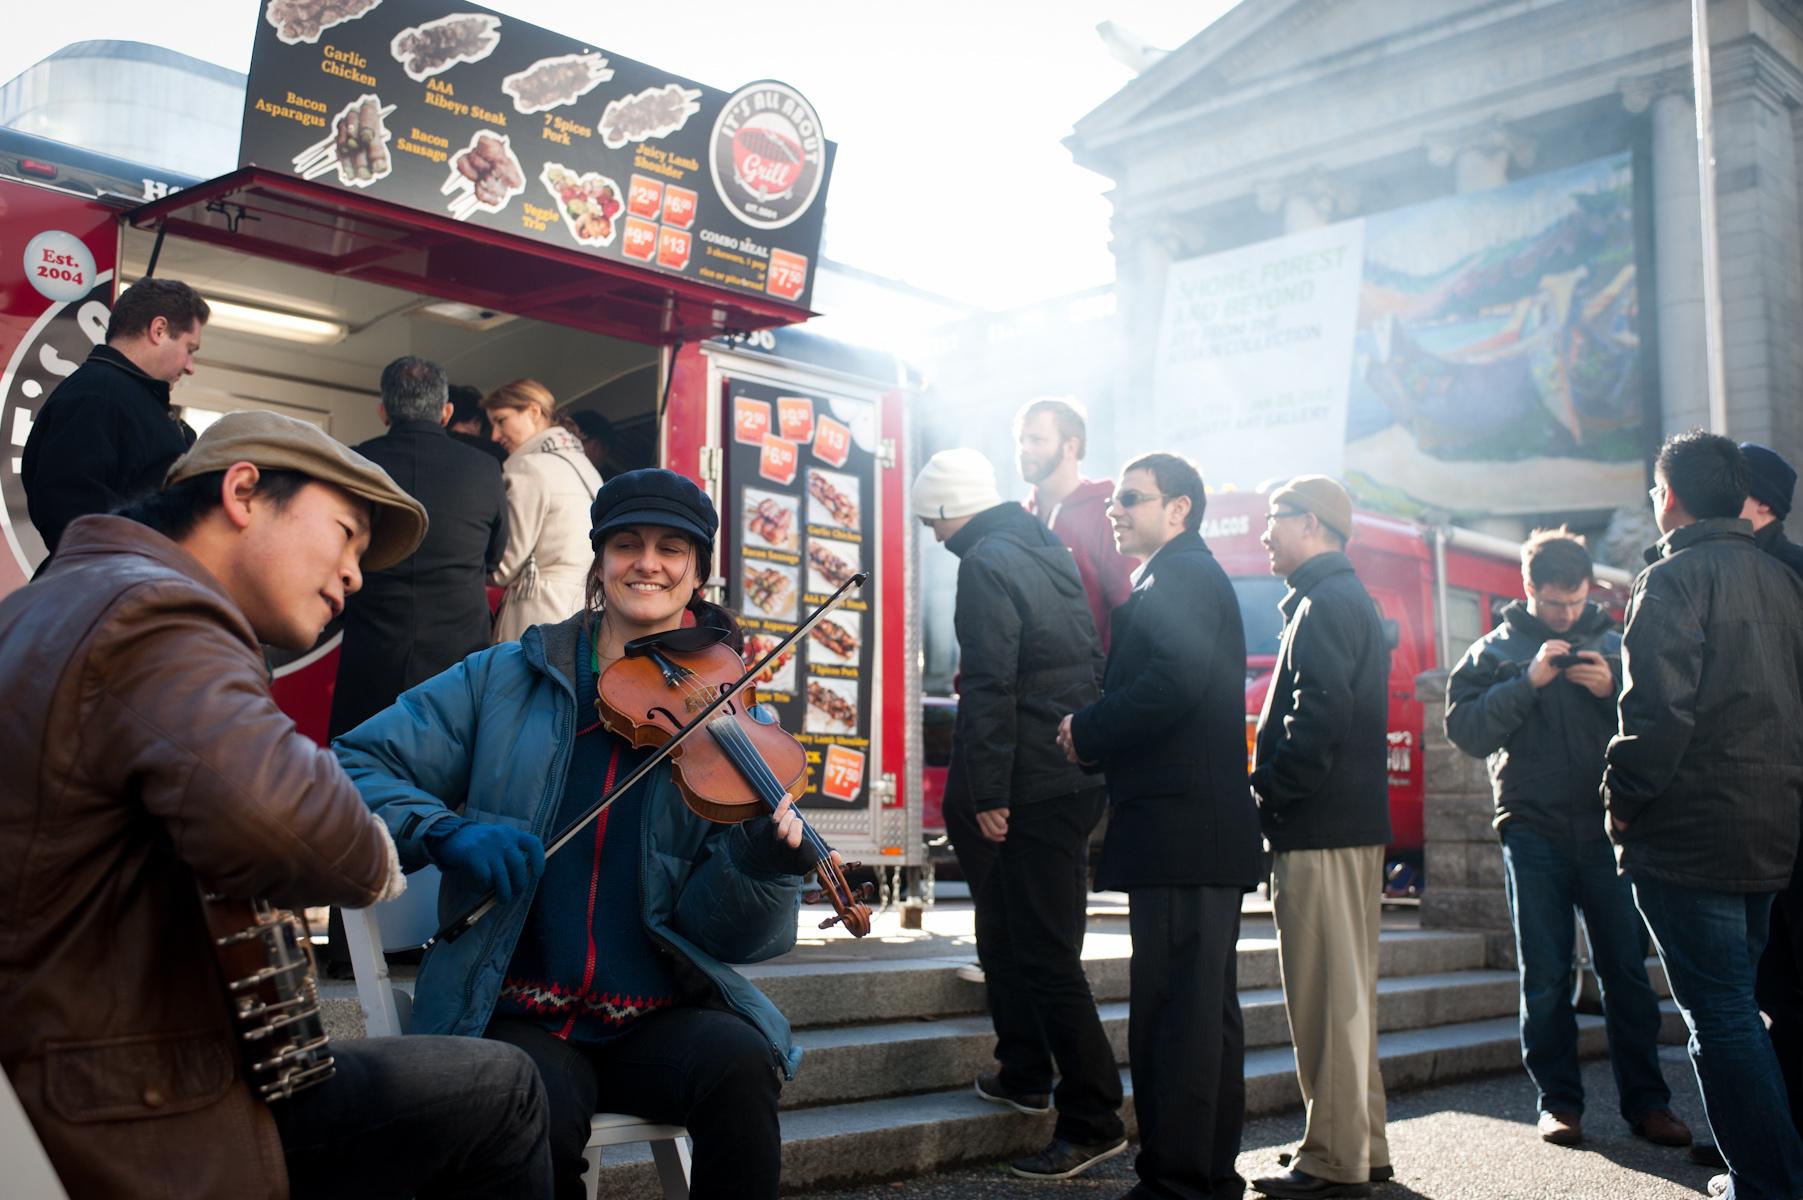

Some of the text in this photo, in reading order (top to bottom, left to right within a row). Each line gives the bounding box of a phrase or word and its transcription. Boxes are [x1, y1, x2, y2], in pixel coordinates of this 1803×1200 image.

[324, 45, 367, 68] Garlic
[321, 60, 376, 87] Chicken
[426, 78, 453, 95] AAA
[255, 98, 327, 128] Asparagus
[287, 91, 327, 113] Bacon
[424, 92, 507, 127] Ribeye Steak
[410, 128, 449, 148] Bacon
[542, 127, 571, 146] Pork
[544, 113, 592, 138] 7 Spices
[753, 91, 780, 111] ALL
[781, 98, 819, 165] ABOUT
[397, 138, 448, 163] Sausage
[636, 143, 699, 172] Juicy Lamb
[634, 154, 685, 180] Shoulder
[742, 153, 791, 187] Grill
[523, 202, 560, 222] Veggie
[523, 215, 546, 232] Trio
[662, 234, 686, 256] $13
[699, 229, 769, 259] COMBO MEAL
[42, 248, 79, 268] Est.
[1260, 245, 1348, 282] FOREST
[37, 264, 84, 286] 2004
[1223, 280, 1315, 320] BEYOND
